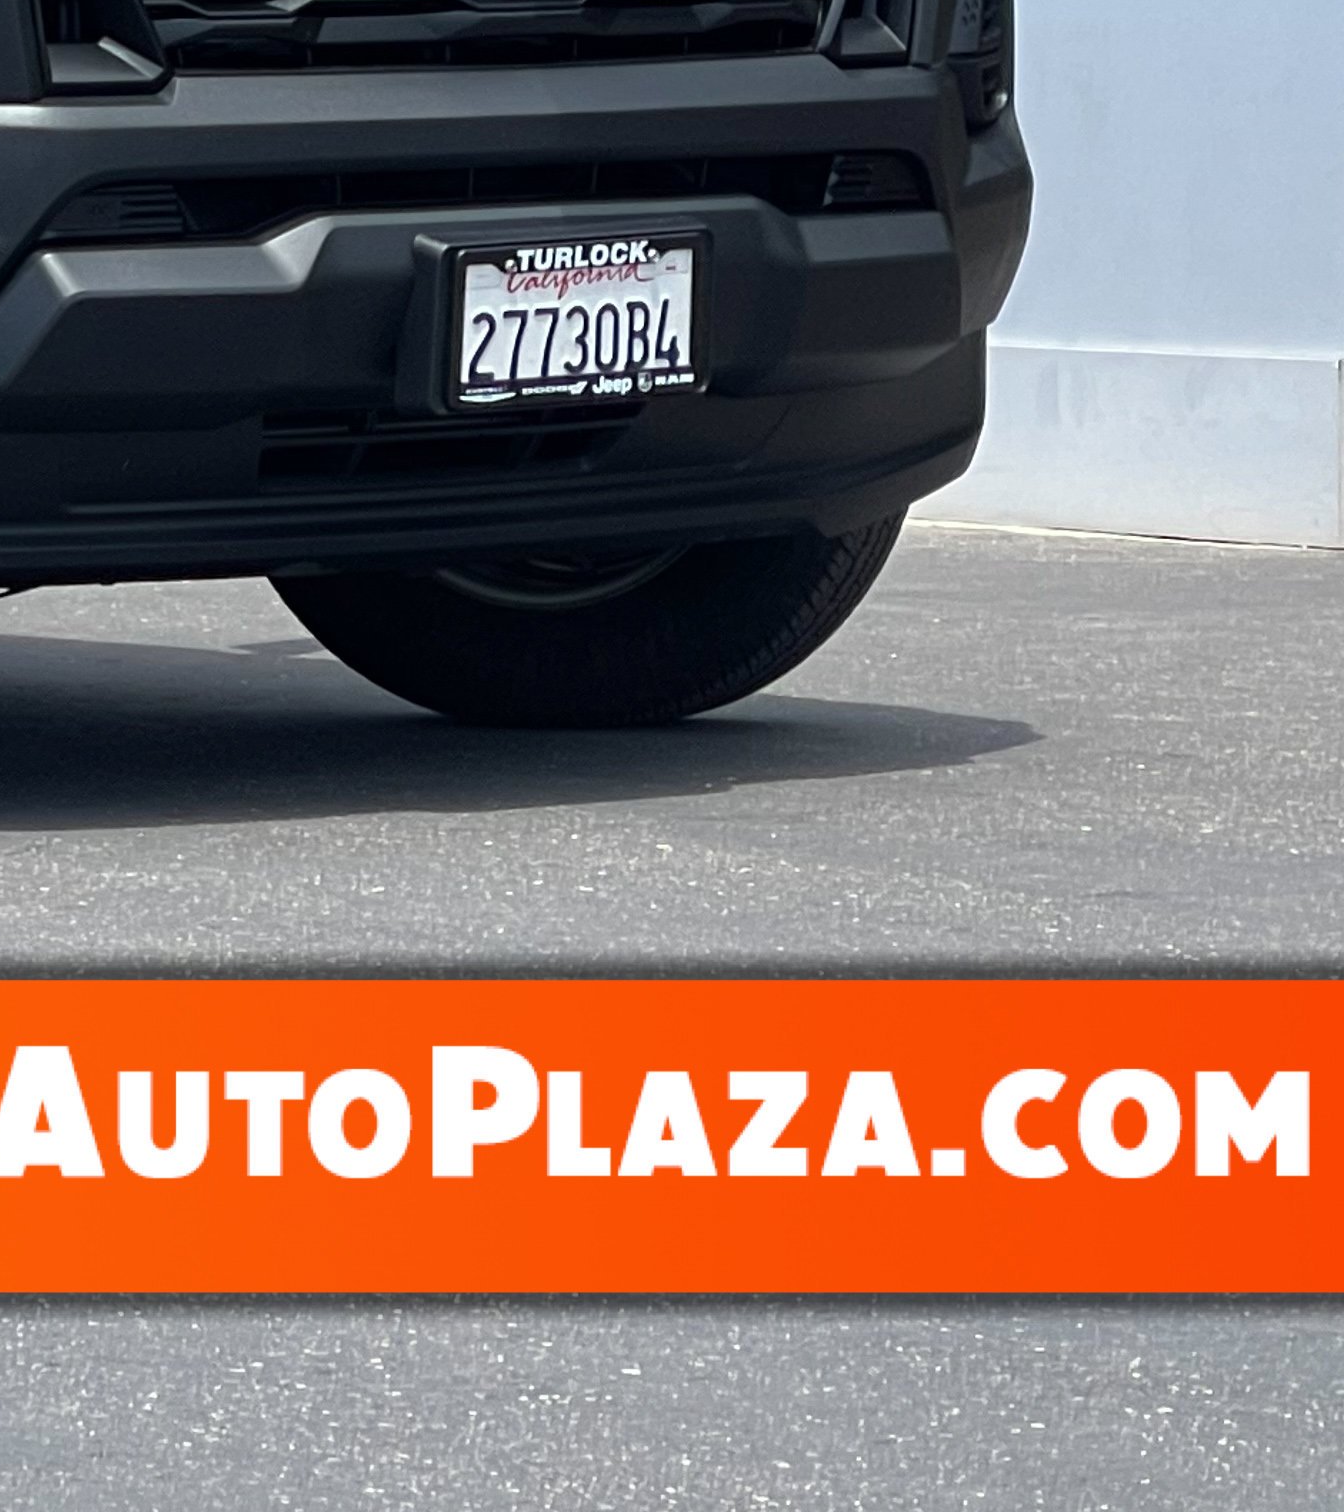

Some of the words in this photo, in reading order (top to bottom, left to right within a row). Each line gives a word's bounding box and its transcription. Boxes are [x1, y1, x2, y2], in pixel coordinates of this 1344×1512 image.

[516, 240, 649, 272] TURLOCK
[505, 263, 655, 299] California
[468, 298, 681, 386] 27730B4
[592, 375, 633, 396] Jeep
